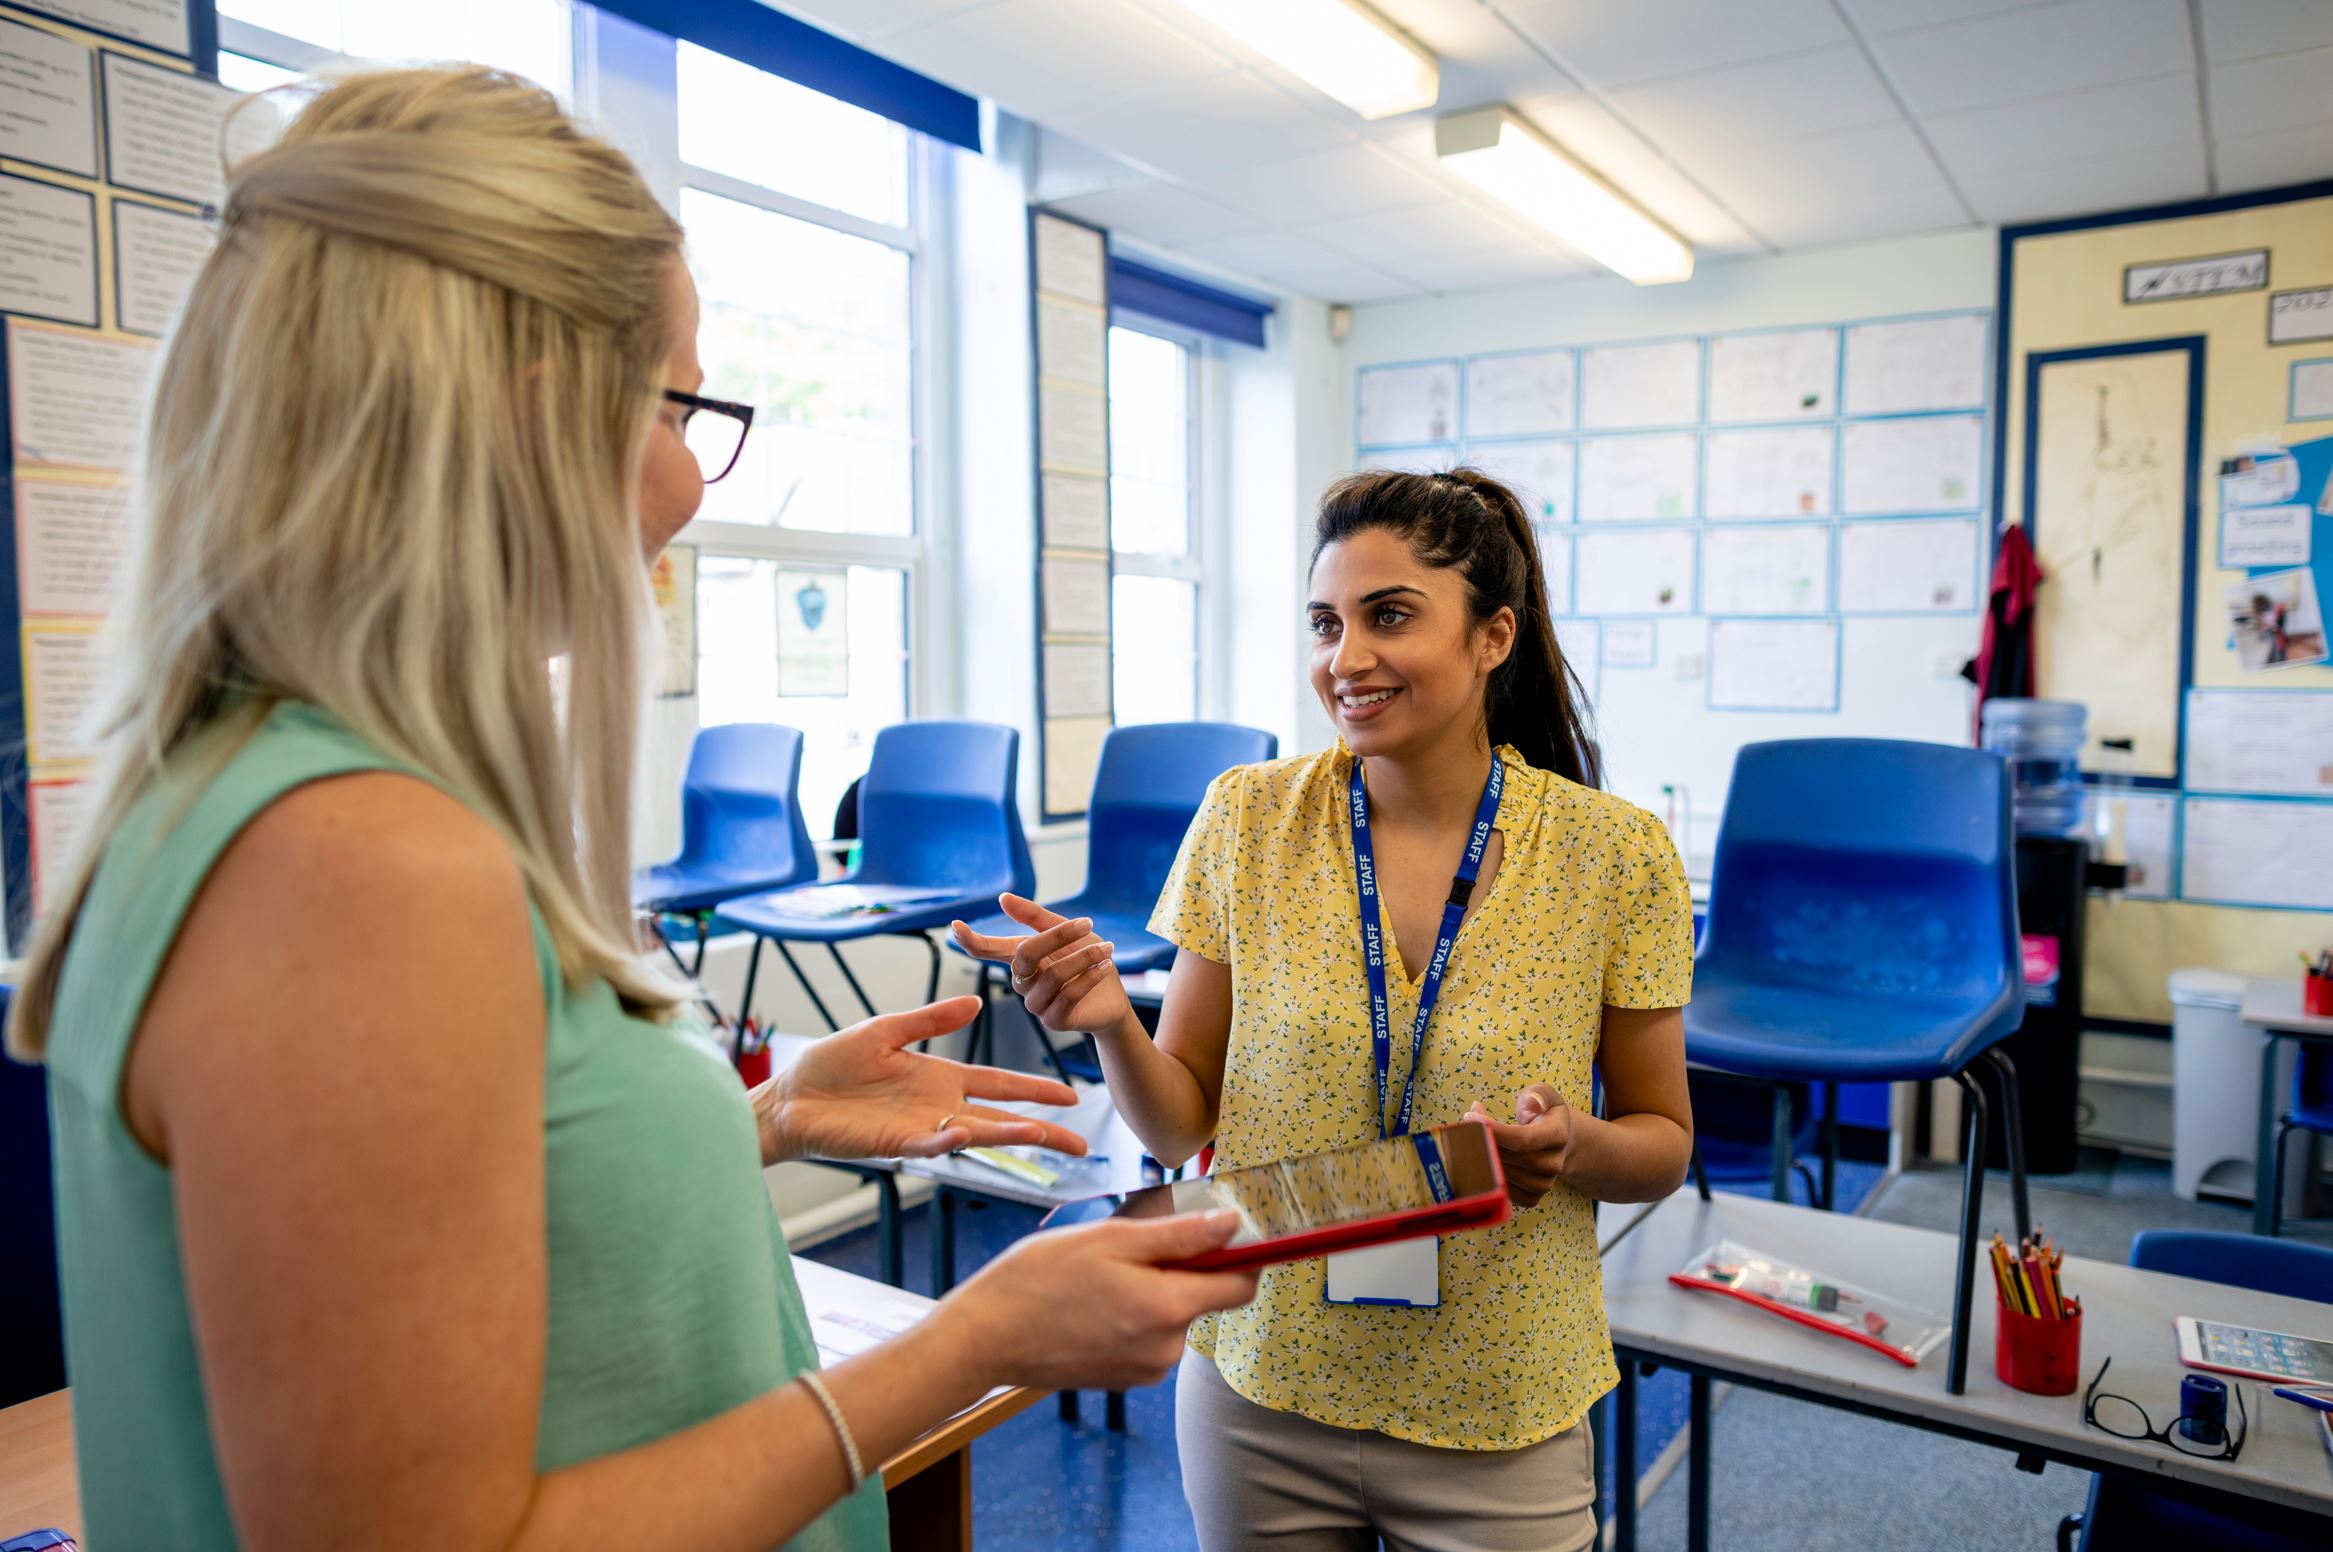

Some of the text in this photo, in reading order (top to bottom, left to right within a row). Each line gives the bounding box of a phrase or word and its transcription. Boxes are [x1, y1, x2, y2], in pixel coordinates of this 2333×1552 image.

[1490, 760, 1501, 799] STAFF
[1352, 788, 1366, 828] STAFF
[1468, 821, 1489, 864] STAFF
[1359, 854, 1374, 896] STAFF
[1367, 923, 1381, 967] STAFF
[1429, 938, 1450, 981] STAFF
[1374, 995, 1387, 1039] STAFF
[1414, 1007, 1428, 1052] STAFF
[1401, 1081, 1413, 1124] STAFF
